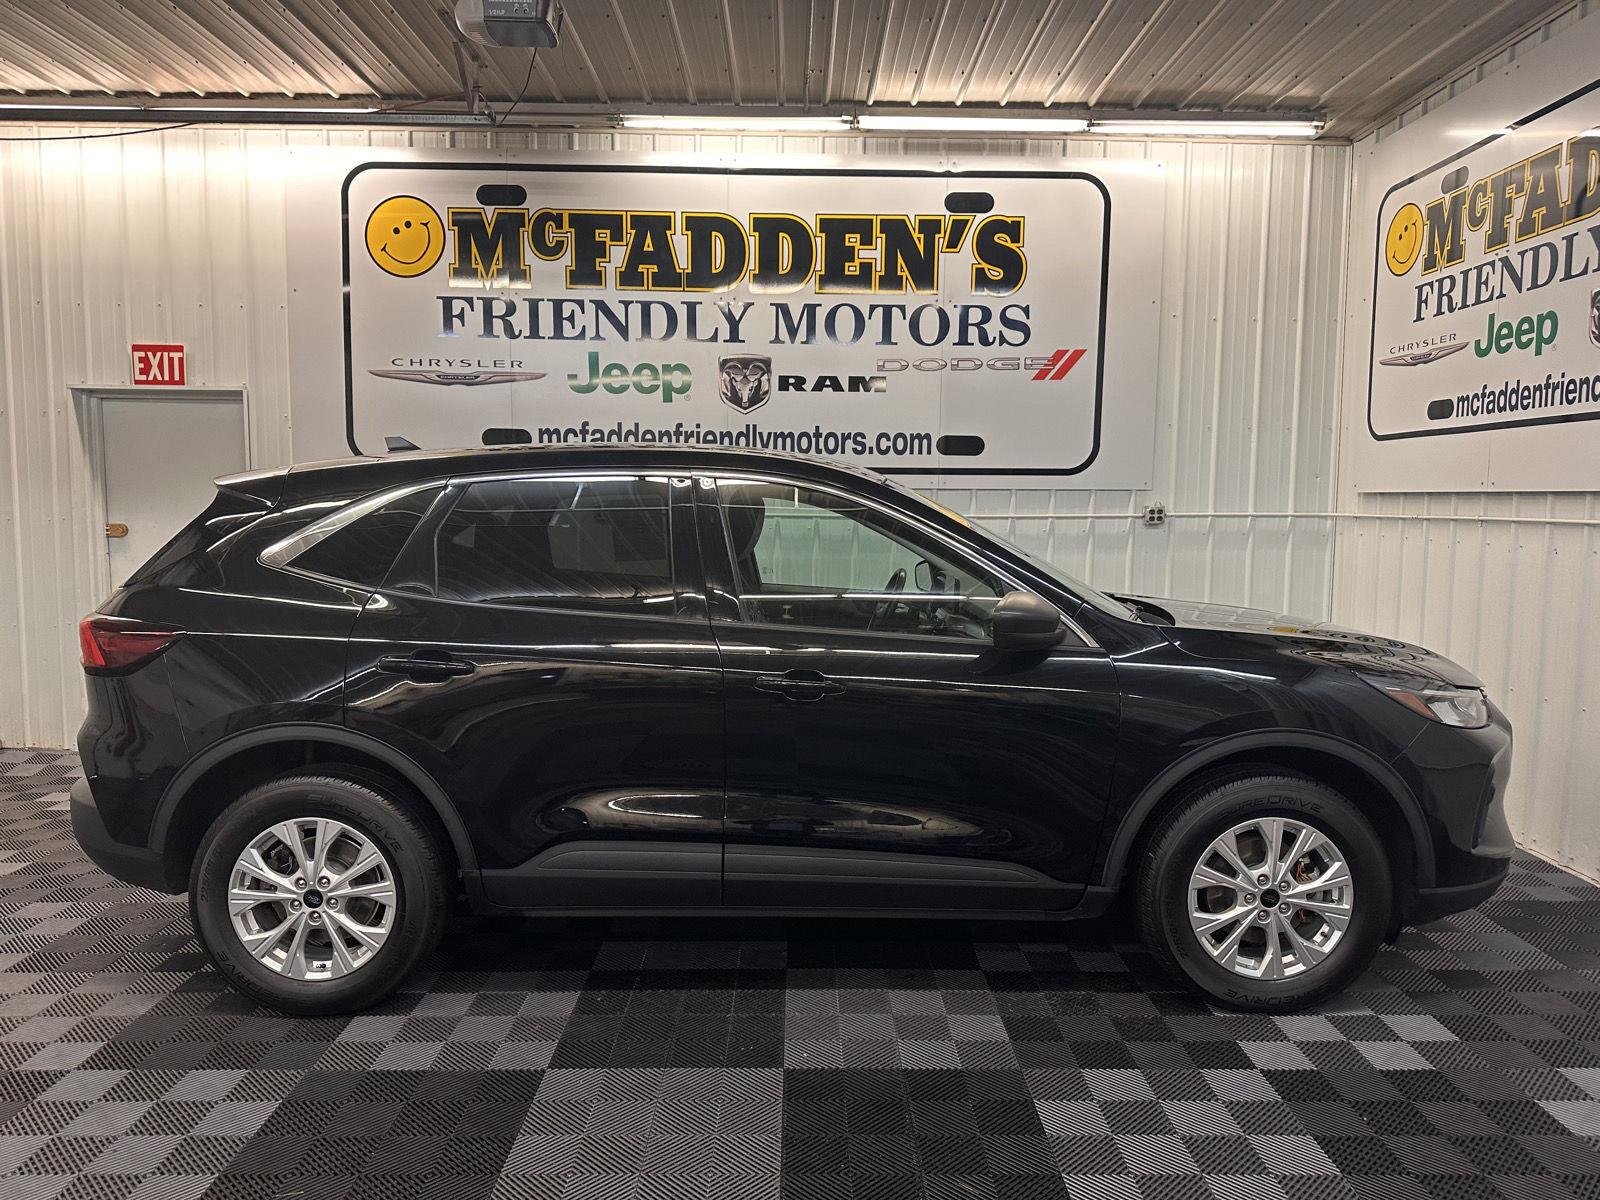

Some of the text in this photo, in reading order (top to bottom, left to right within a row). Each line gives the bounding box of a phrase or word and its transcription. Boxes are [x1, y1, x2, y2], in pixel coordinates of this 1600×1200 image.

[447, 206, 1028, 297] McFADDEN'S
[436, 295, 1032, 346] FRIENDLY MOTORS
[1474, 309, 1559, 358] Jeep
[1389, 333, 1457, 355] CHRYSLER
[133, 351, 183, 381] EXIT
[391, 358, 525, 369] CHRYSLER
[566, 352, 693, 403] Jeep
[876, 357, 1056, 372] DODGE
[777, 375, 887, 393] RAM
